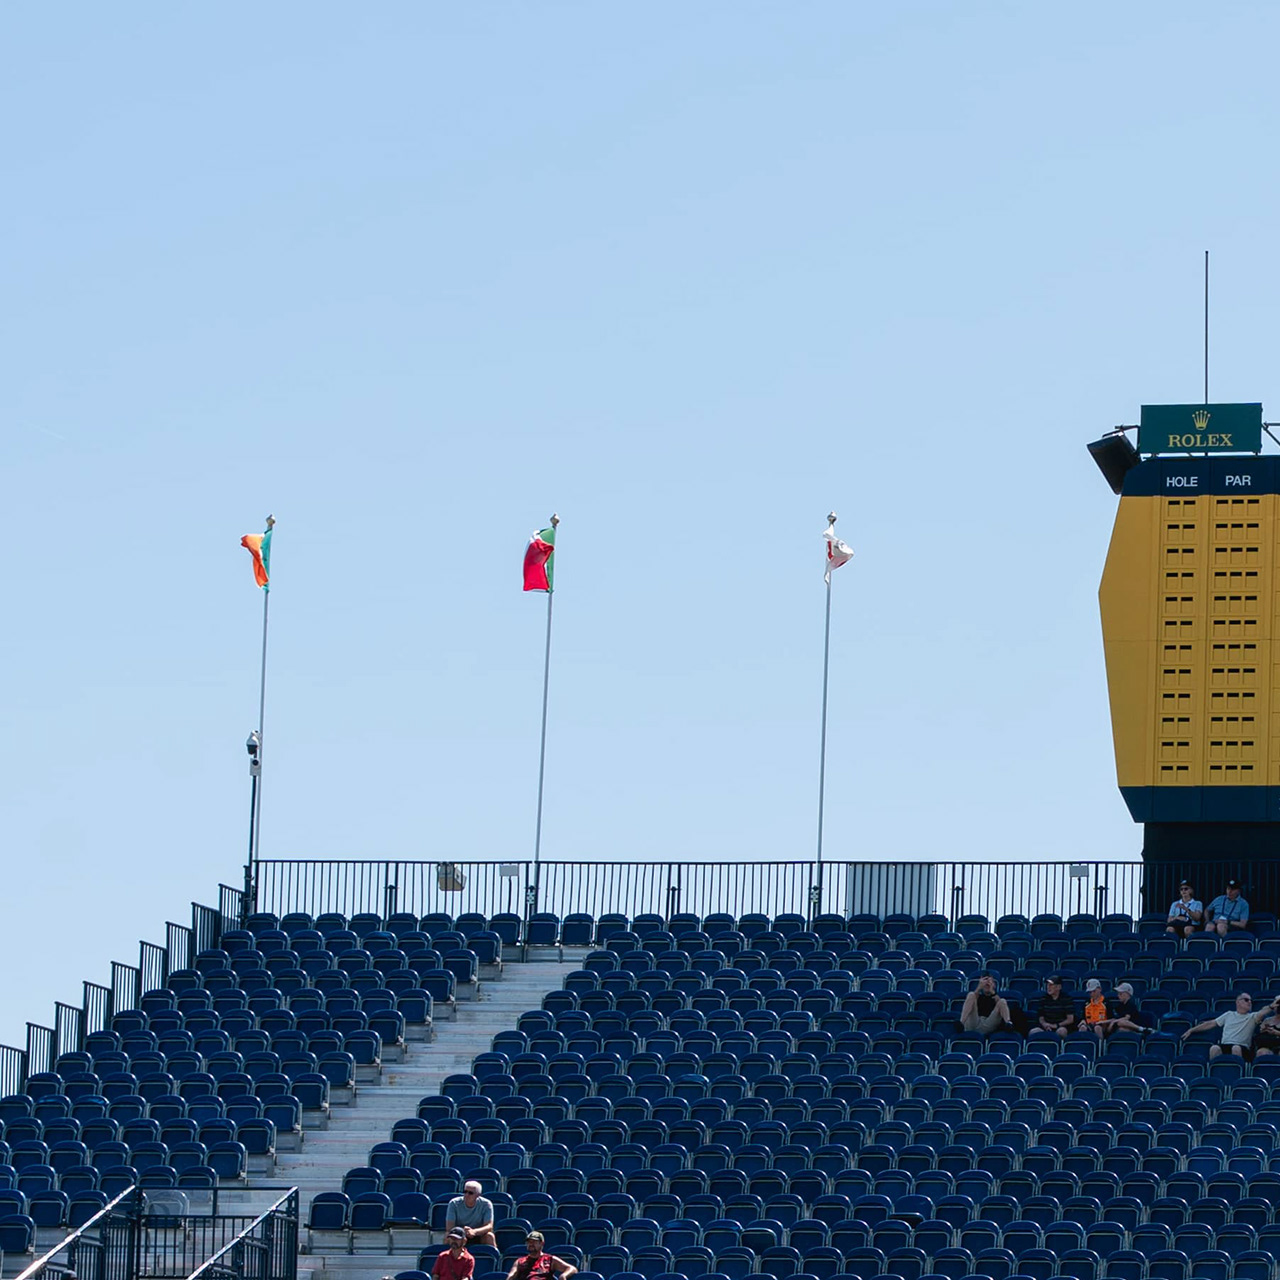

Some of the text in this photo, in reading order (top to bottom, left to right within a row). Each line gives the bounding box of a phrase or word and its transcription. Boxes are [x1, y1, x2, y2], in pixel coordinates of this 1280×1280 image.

[1168, 433, 1233, 447] ROLEX
[1166, 476, 1198, 487] HOLE
[1225, 475, 1251, 486] PAR
